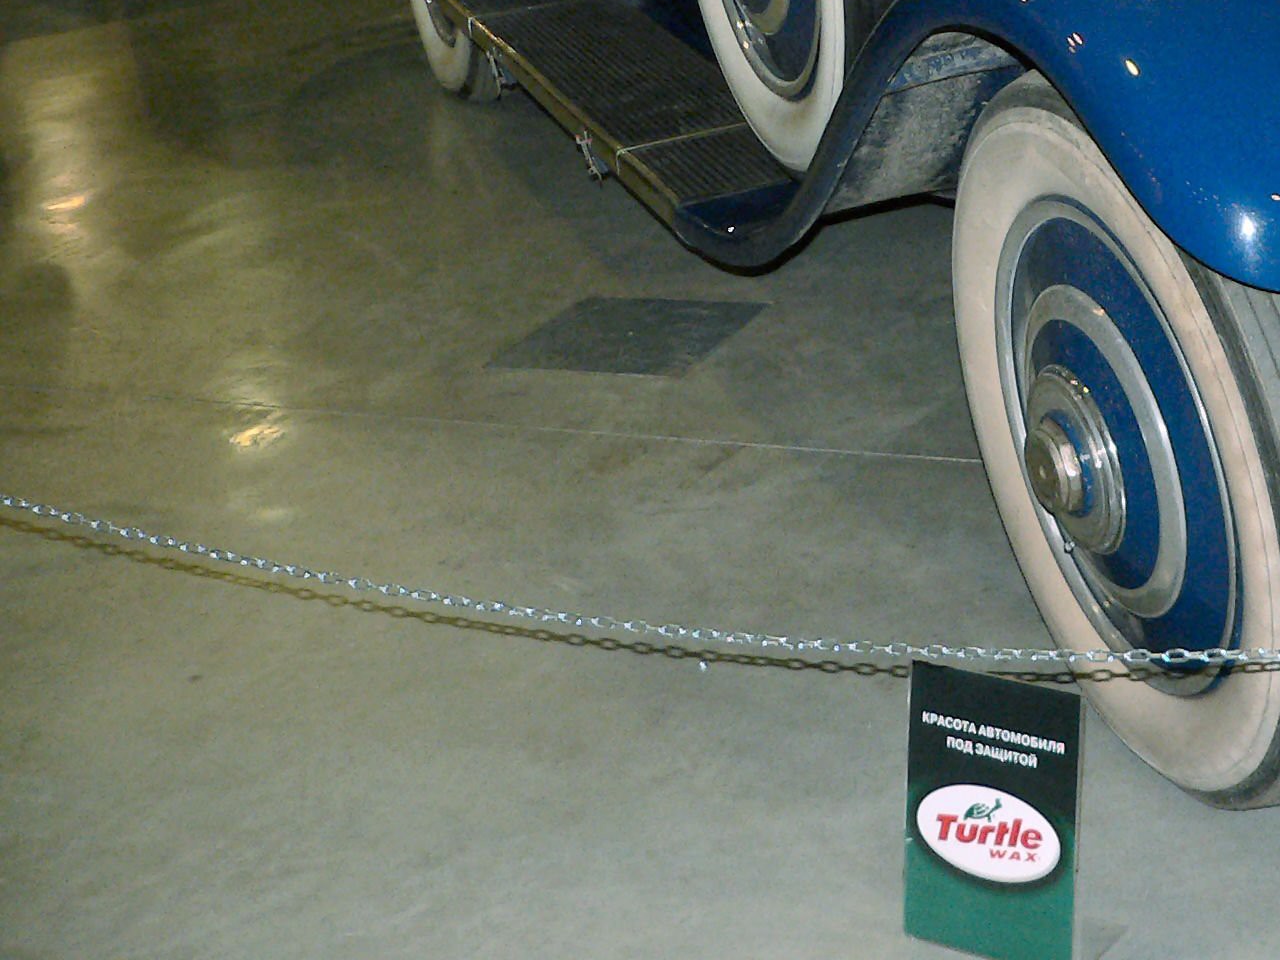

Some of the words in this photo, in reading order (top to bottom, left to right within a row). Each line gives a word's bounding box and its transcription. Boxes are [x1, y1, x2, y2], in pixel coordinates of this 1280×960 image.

[922, 710, 977, 735] КРАСОТА
[978, 723, 1066, 755] АВТОМОБИЛЯ
[946, 735, 974, 755] ПОД
[975, 742, 1039, 769] ЗАЩИТОЙ
[936, 813, 1043, 850] Turtle
[989, 848, 1038, 863] WAX
